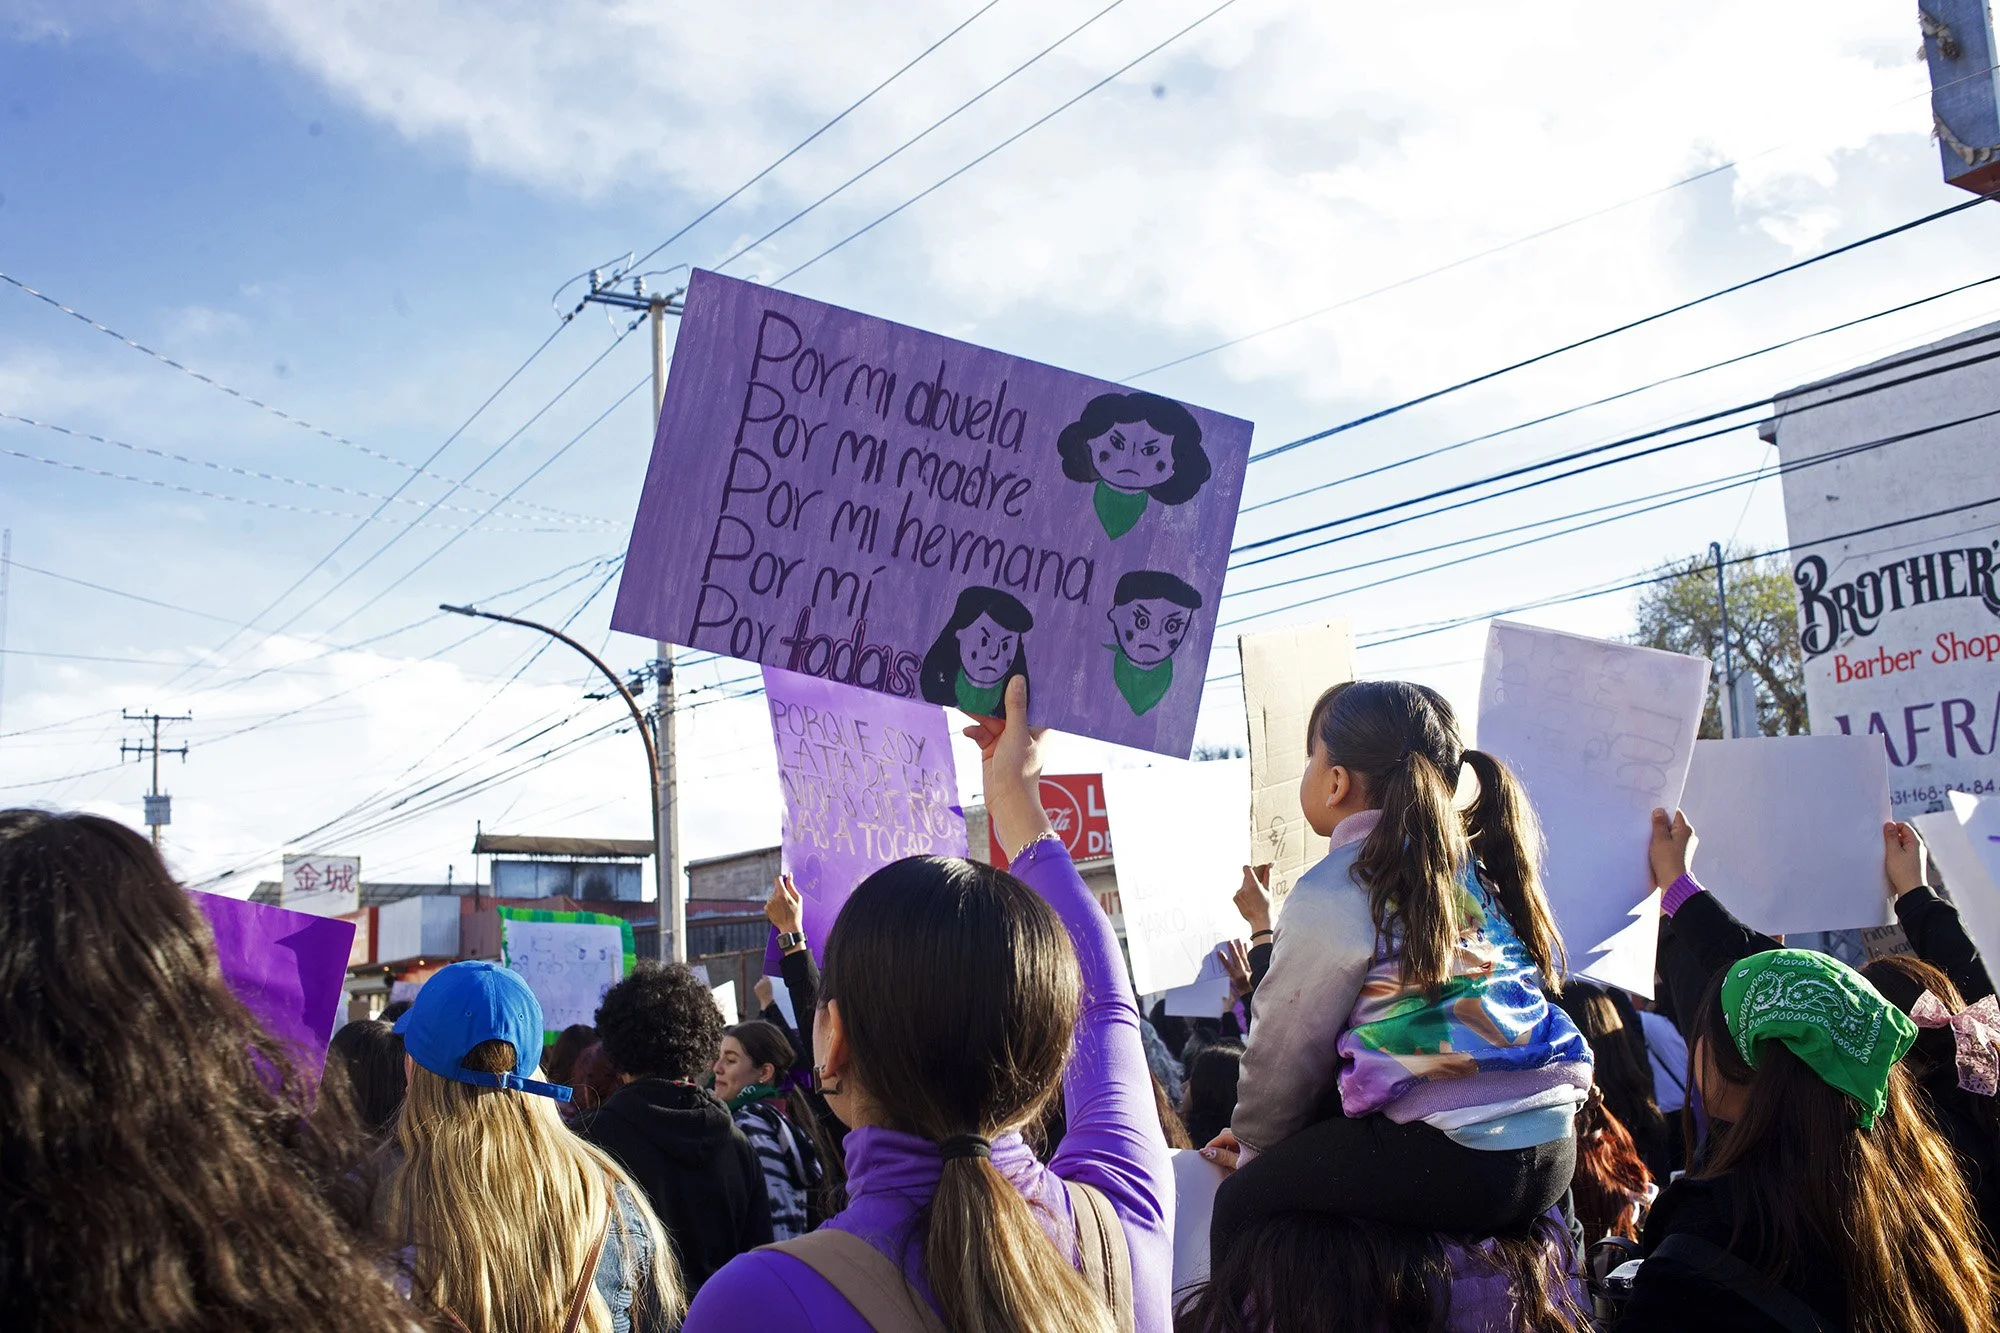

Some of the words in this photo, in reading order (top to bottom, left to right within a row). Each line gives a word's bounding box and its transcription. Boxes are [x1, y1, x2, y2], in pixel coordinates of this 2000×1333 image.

[750, 309, 851, 394] Por
[843, 361, 895, 421] mi
[904, 360, 1027, 453] abuela
[734, 381, 828, 462] Por
[833, 431, 888, 484] mi
[897, 447, 1033, 517] madre
[701, 515, 805, 599] Por
[811, 564, 887, 620] mí
[719, 448, 823, 530] Por
[830, 499, 880, 553] mi
[893, 494, 1096, 606] hermana
[688, 583, 776, 663] Por
[780, 605, 921, 699] todas
[1794, 538, 2000, 664] BROTHER'
[1834, 645, 1922, 684] Barber
[1931, 631, 2000, 664] Shop
[771, 698, 876, 756] PORQUE
[882, 726, 926, 767] SOY
[777, 733, 819, 774] LA
[862, 754, 895, 791] DE
[785, 809, 830, 850] VAS
[833, 816, 856, 856] A
[861, 787, 905, 828] QUE
[909, 791, 953, 839] NO
